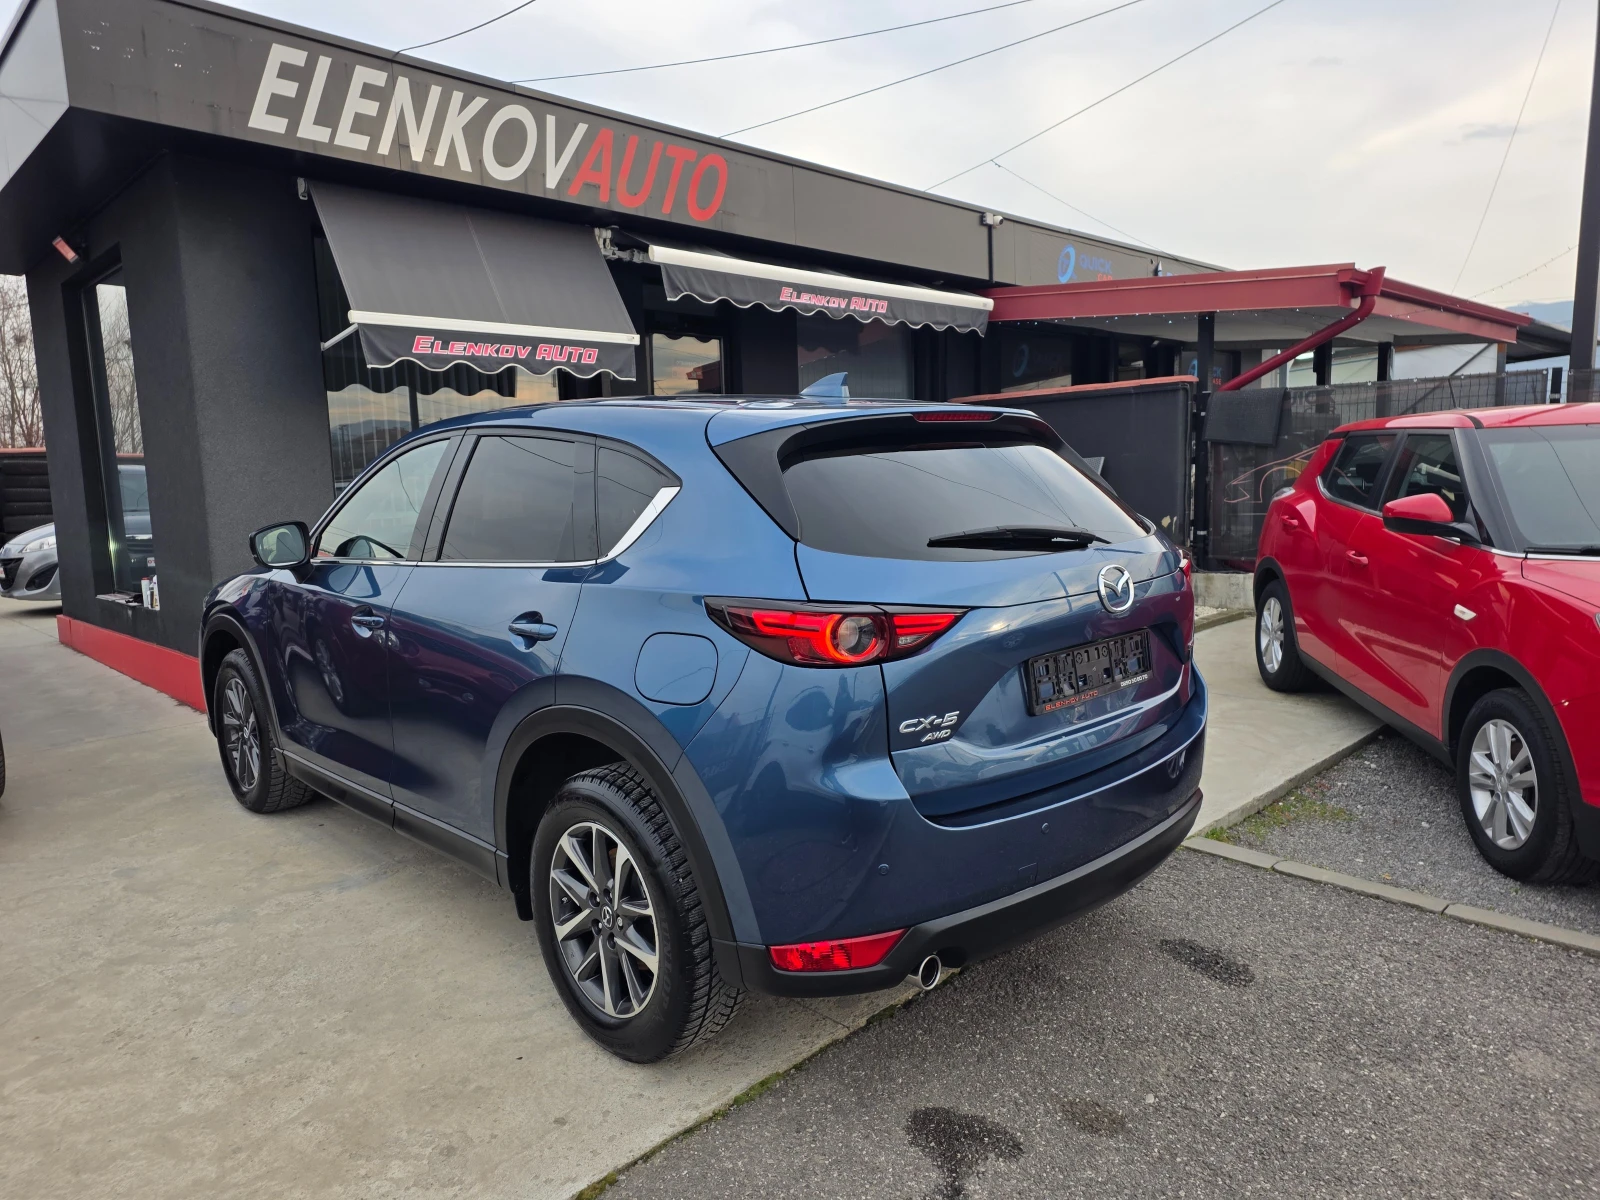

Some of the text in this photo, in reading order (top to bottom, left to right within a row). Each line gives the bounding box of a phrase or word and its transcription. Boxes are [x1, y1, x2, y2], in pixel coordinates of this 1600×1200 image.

[1079, 253, 1113, 274] QUICK
[849, 296, 888, 313] AUTO
[535, 343, 599, 364] AUTO
[899, 710, 960, 733] CX-5
[920, 728, 952, 742] AWD
